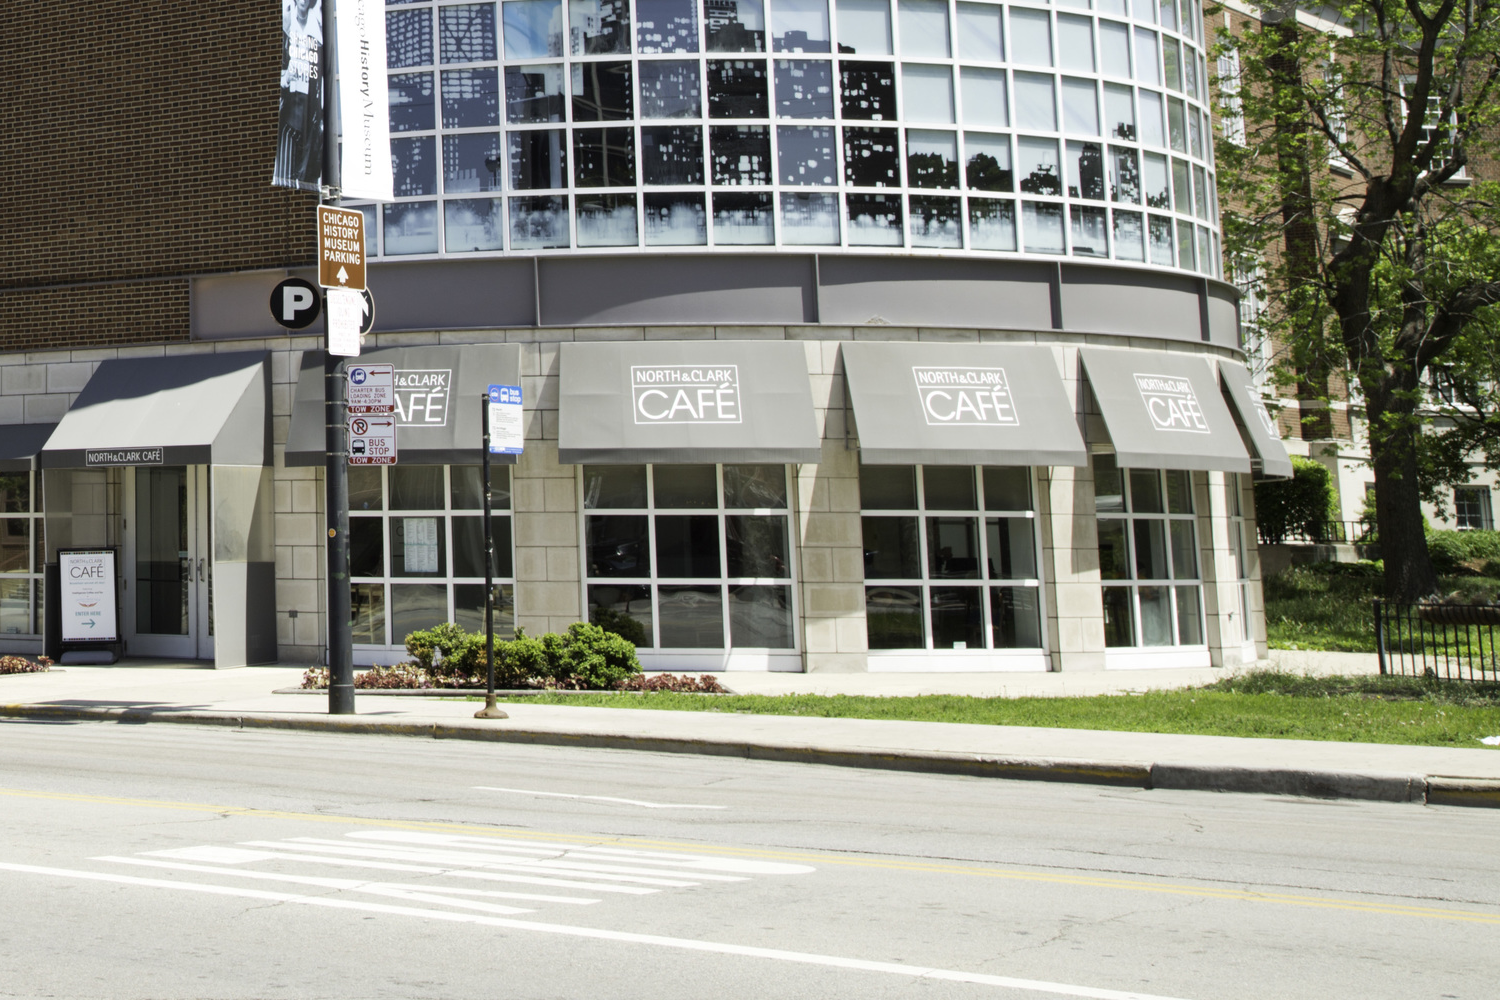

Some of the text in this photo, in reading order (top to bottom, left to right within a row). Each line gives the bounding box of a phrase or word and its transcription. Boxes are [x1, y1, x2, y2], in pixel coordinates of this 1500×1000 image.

[323, 212, 359, 227] CHICAGO
[323, 225, 359, 240] HISTORY
[324, 237, 360, 252] MUSEUM
[324, 249, 360, 265] PARKING
[283, 286, 314, 320] P
[636, 369, 732, 382] NORTH&CLARK
[918, 371, 1003, 384] NORTH&CLARK
[1138, 378, 1191, 393] NORTH&CLARK
[394, 386, 445, 422] AFÉ
[638, 382, 736, 419] CAFÉ
[926, 384, 1014, 421] CAFÉ
[1148, 394, 1206, 429] CAFÉ
[142, 448, 160, 461] CAFÉ
[369, 447, 390, 455] STOP
[70, 564, 104, 578] CAFÉ
